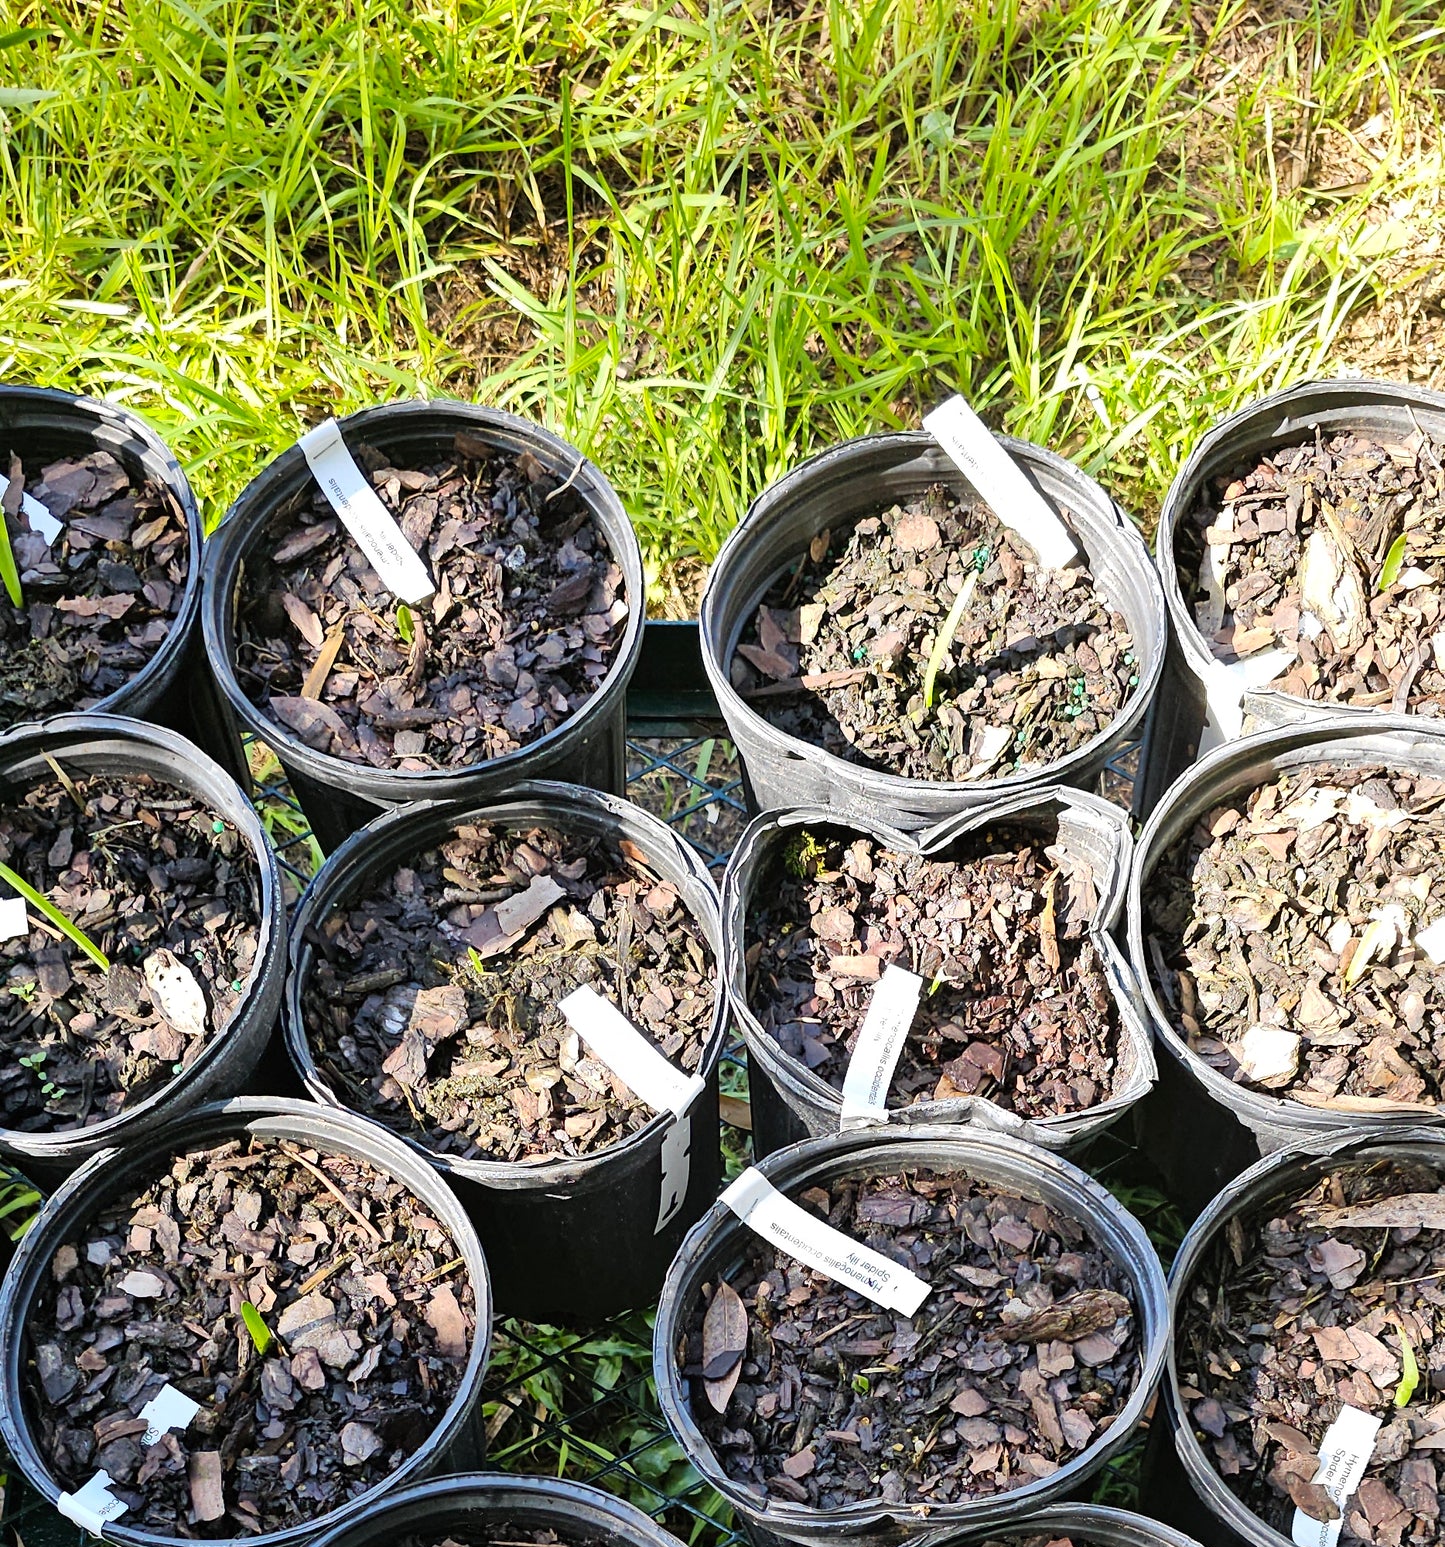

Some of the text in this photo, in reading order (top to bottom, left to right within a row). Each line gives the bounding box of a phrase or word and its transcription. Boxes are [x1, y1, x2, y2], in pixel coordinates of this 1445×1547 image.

[846, 1252, 891, 1283] Spider lily
[1326, 1447, 1346, 1482] Spider
